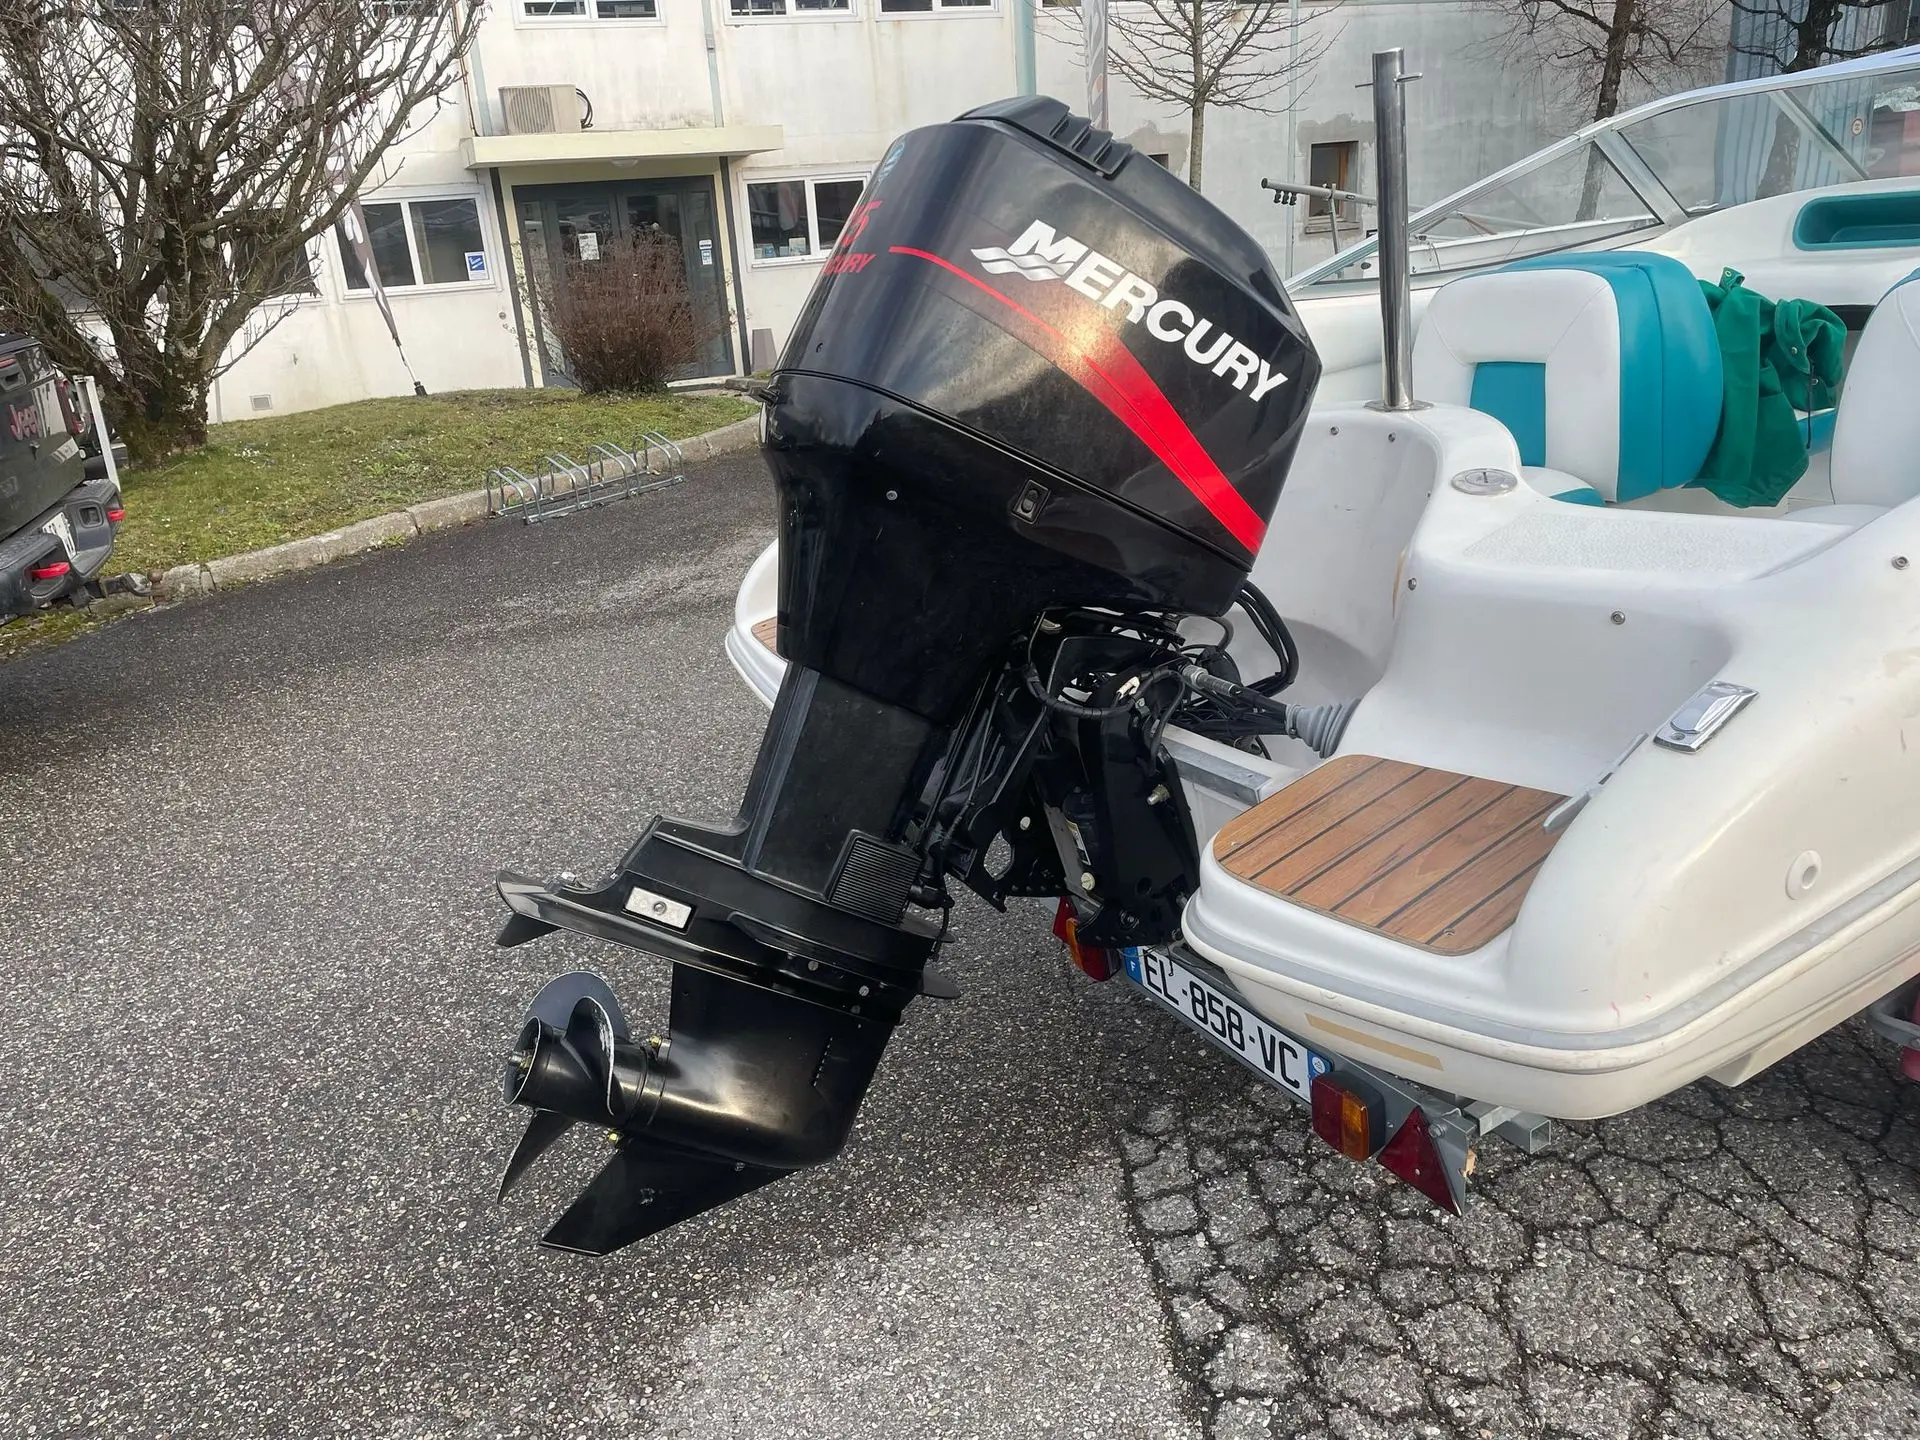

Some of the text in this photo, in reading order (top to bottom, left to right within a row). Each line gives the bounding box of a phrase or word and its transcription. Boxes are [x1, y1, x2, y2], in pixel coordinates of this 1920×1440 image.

[1007, 219, 1289, 403] MERCURY
[9, 404, 43, 441] Jeep
[1143, 950, 1300, 1090] EL-858-VC
